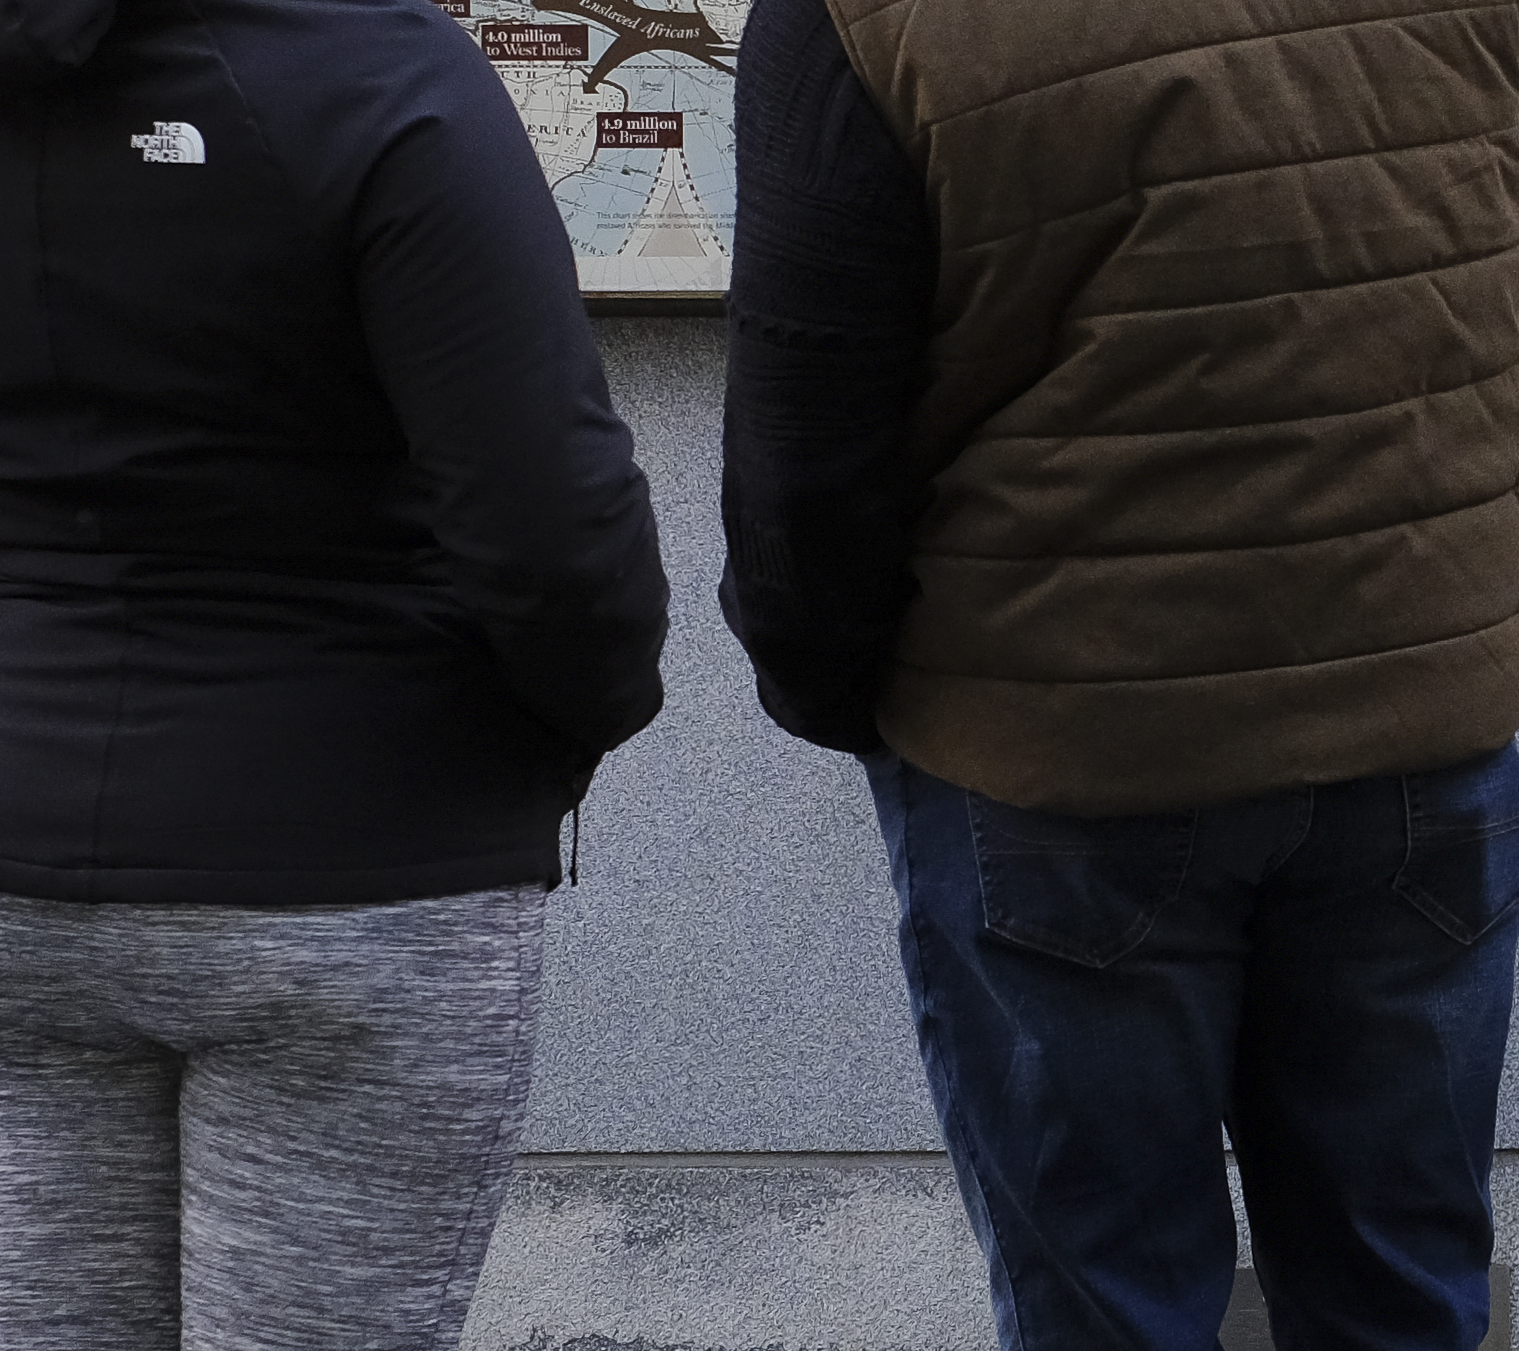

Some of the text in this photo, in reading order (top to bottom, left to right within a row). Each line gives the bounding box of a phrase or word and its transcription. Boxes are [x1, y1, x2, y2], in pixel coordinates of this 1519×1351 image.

[510, 29, 562, 43] million
[641, 20, 701, 40] Africans
[486, 42, 582, 57] to West Indies
[626, 116, 678, 131] million
[602, 130, 658, 144] to Brazil
